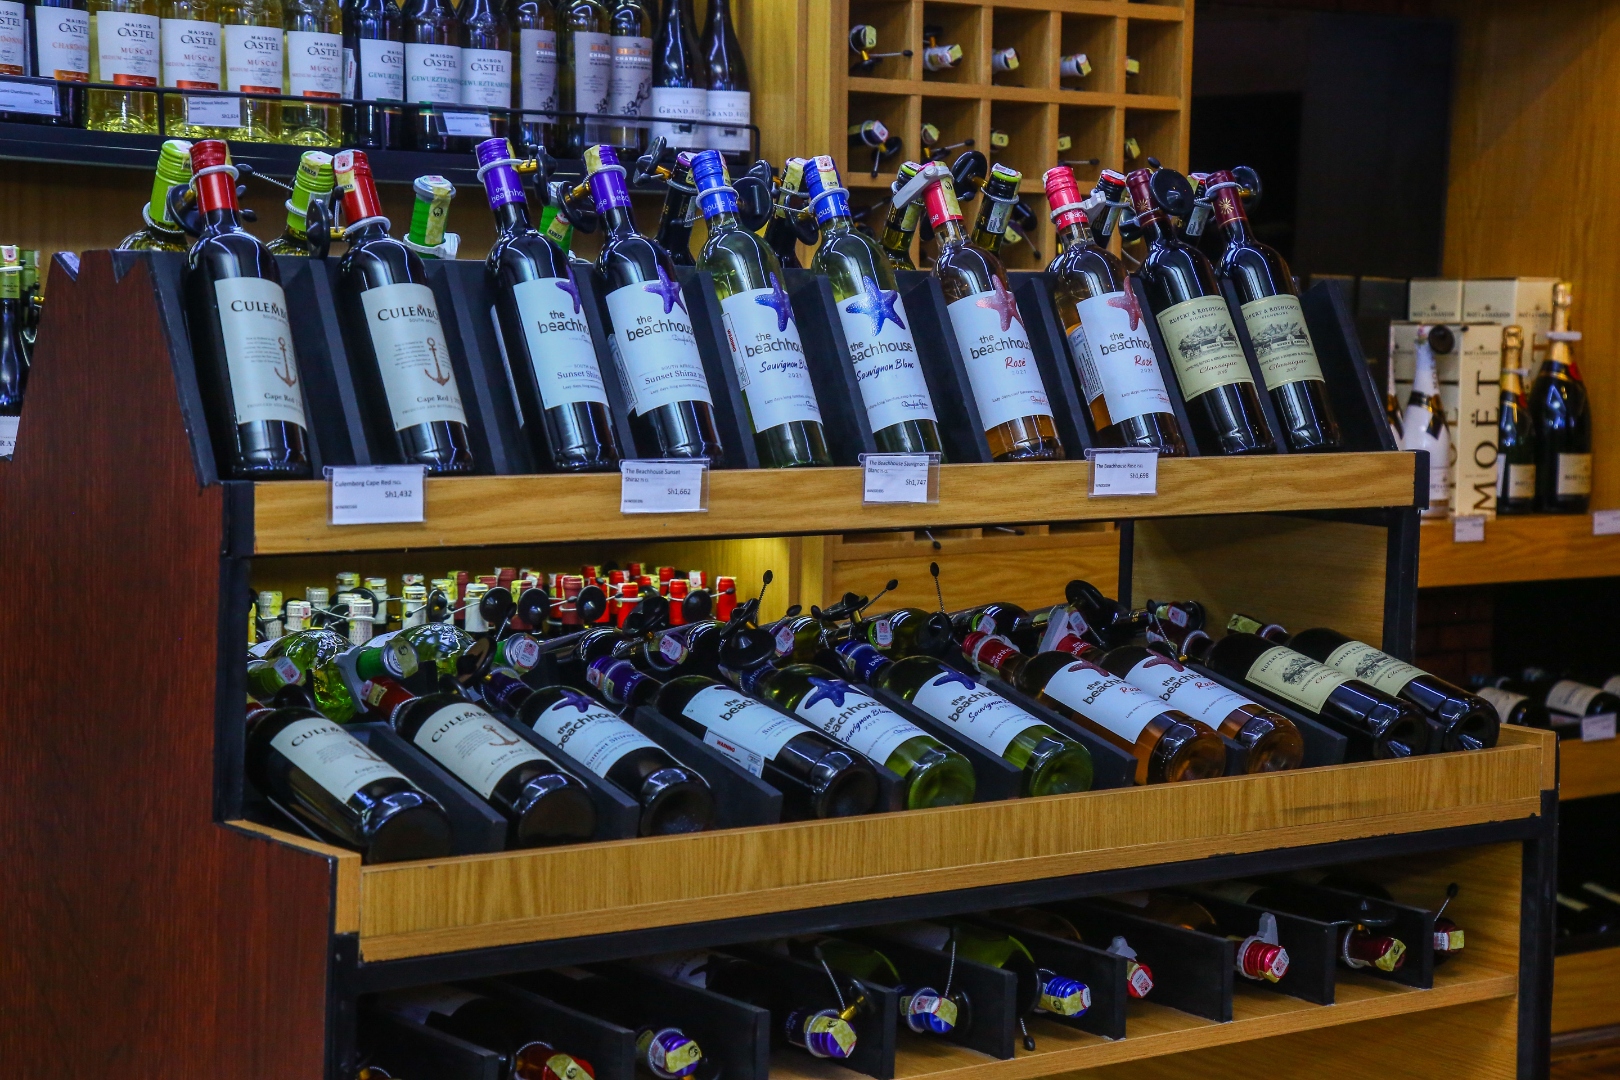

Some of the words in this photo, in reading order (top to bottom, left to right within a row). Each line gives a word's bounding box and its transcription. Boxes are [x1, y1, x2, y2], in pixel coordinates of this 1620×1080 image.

[118, 28, 155, 39] CASTEL
[181, 35, 217, 46] CASTEL
[244, 40, 280, 51] CASTEL
[121, 47, 152, 56] MUSCAT
[308, 46, 340, 57] CASTEL
[424, 58, 457, 68] CASTEL
[471, 62, 505, 73] CASTEL
[659, 106, 688, 114] GRAND
[548, 230, 562, 240] KENYA
[549, 310, 565, 319] the
[636, 315, 652, 325] the
[1169, 312, 1190, 324] RUPERT
[755, 333, 771, 342] the
[979, 334, 994, 344] the
[1110, 332, 1124, 341] the
[850, 342, 864, 352] the
[759, 360, 798, 373] Sauvignon
[857, 365, 893, 382] Sauvignon
[895, 359, 914, 369] Blanc
[1199, 361, 1237, 374] Classique
[1269, 359, 1307, 372] Classique
[557, 371, 584, 379] Sunset
[645, 372, 673, 384] Sunset
[675, 370, 698, 378] Shiraz
[264, 392, 282, 401] Cape
[1086, 681, 1100, 691] the
[1162, 676, 1176, 687] the
[724, 698, 740, 707] the
[951, 696, 966, 706] the
[968, 699, 1002, 723] Sauvignon
[558, 721, 572, 735] the
[824, 717, 836, 731] the
[716, 740, 736, 752] WARNING
[586, 743, 608, 768] Sunset
